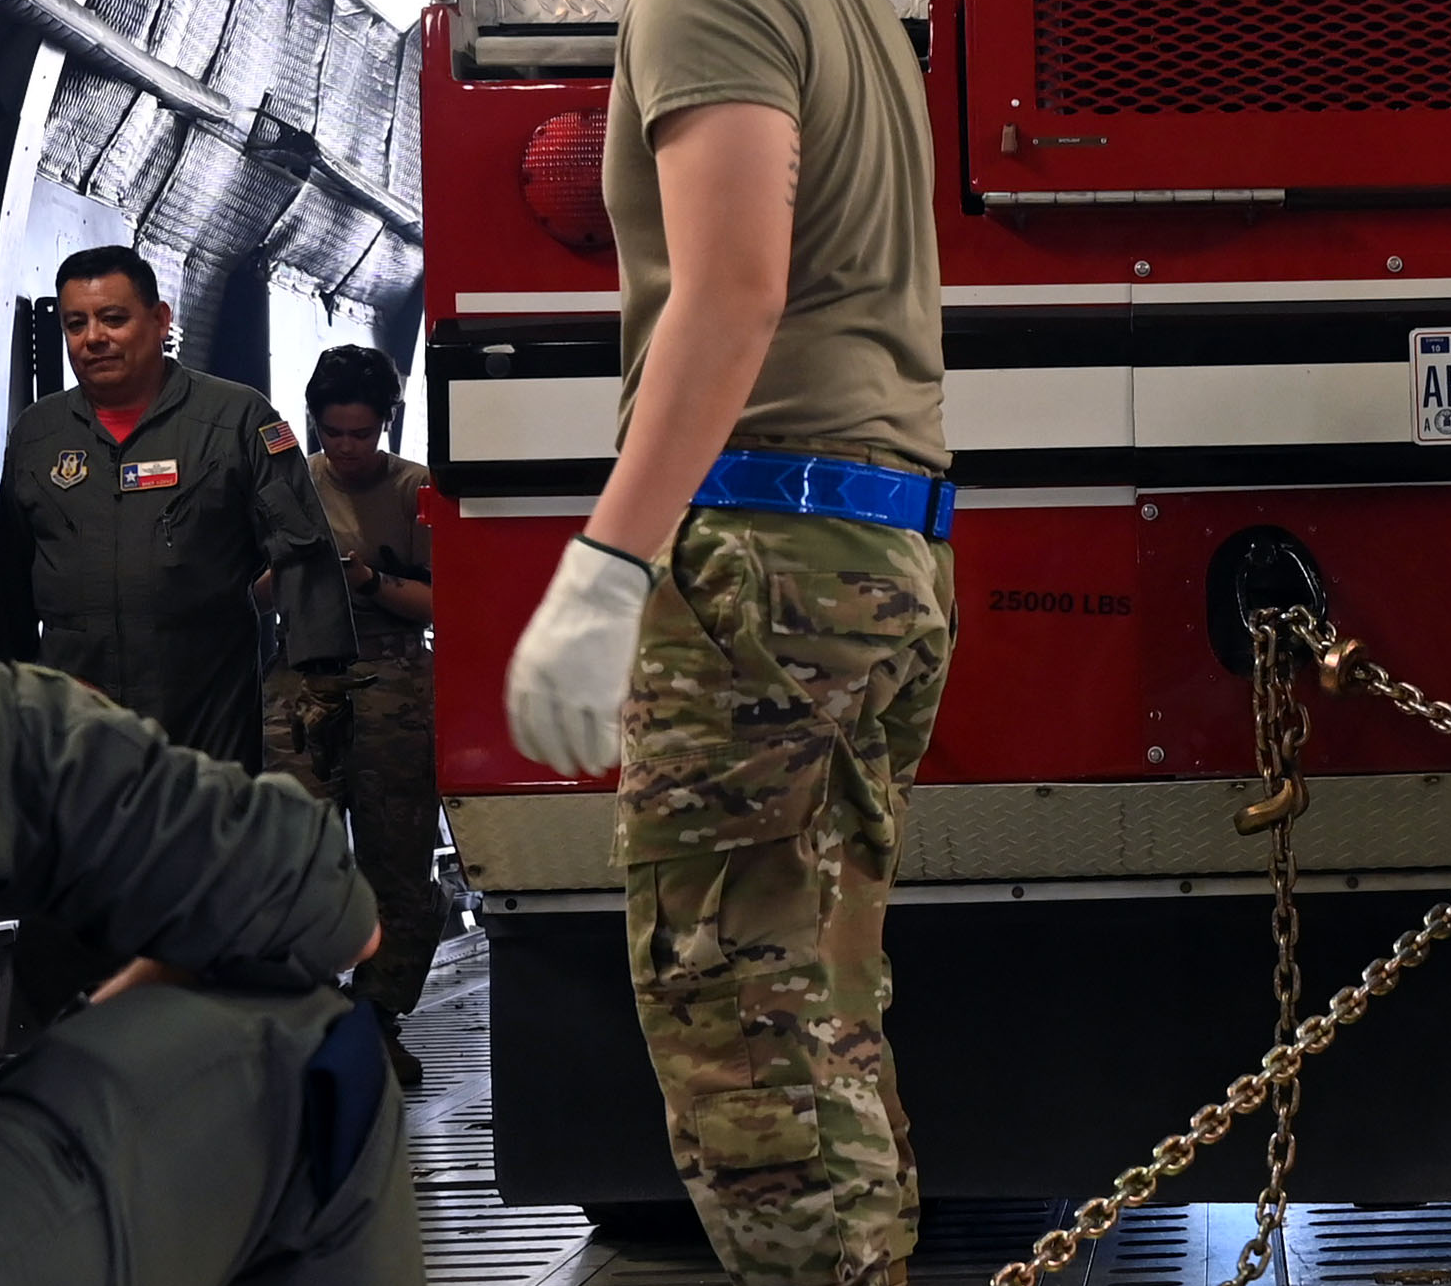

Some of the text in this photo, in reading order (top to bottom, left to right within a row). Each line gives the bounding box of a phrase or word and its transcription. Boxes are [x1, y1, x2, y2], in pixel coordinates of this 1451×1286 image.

[1431, 344, 1441, 353] 10
[1423, 417, 1431, 433] A
[988, 590, 1132, 615] 25000 LBS
